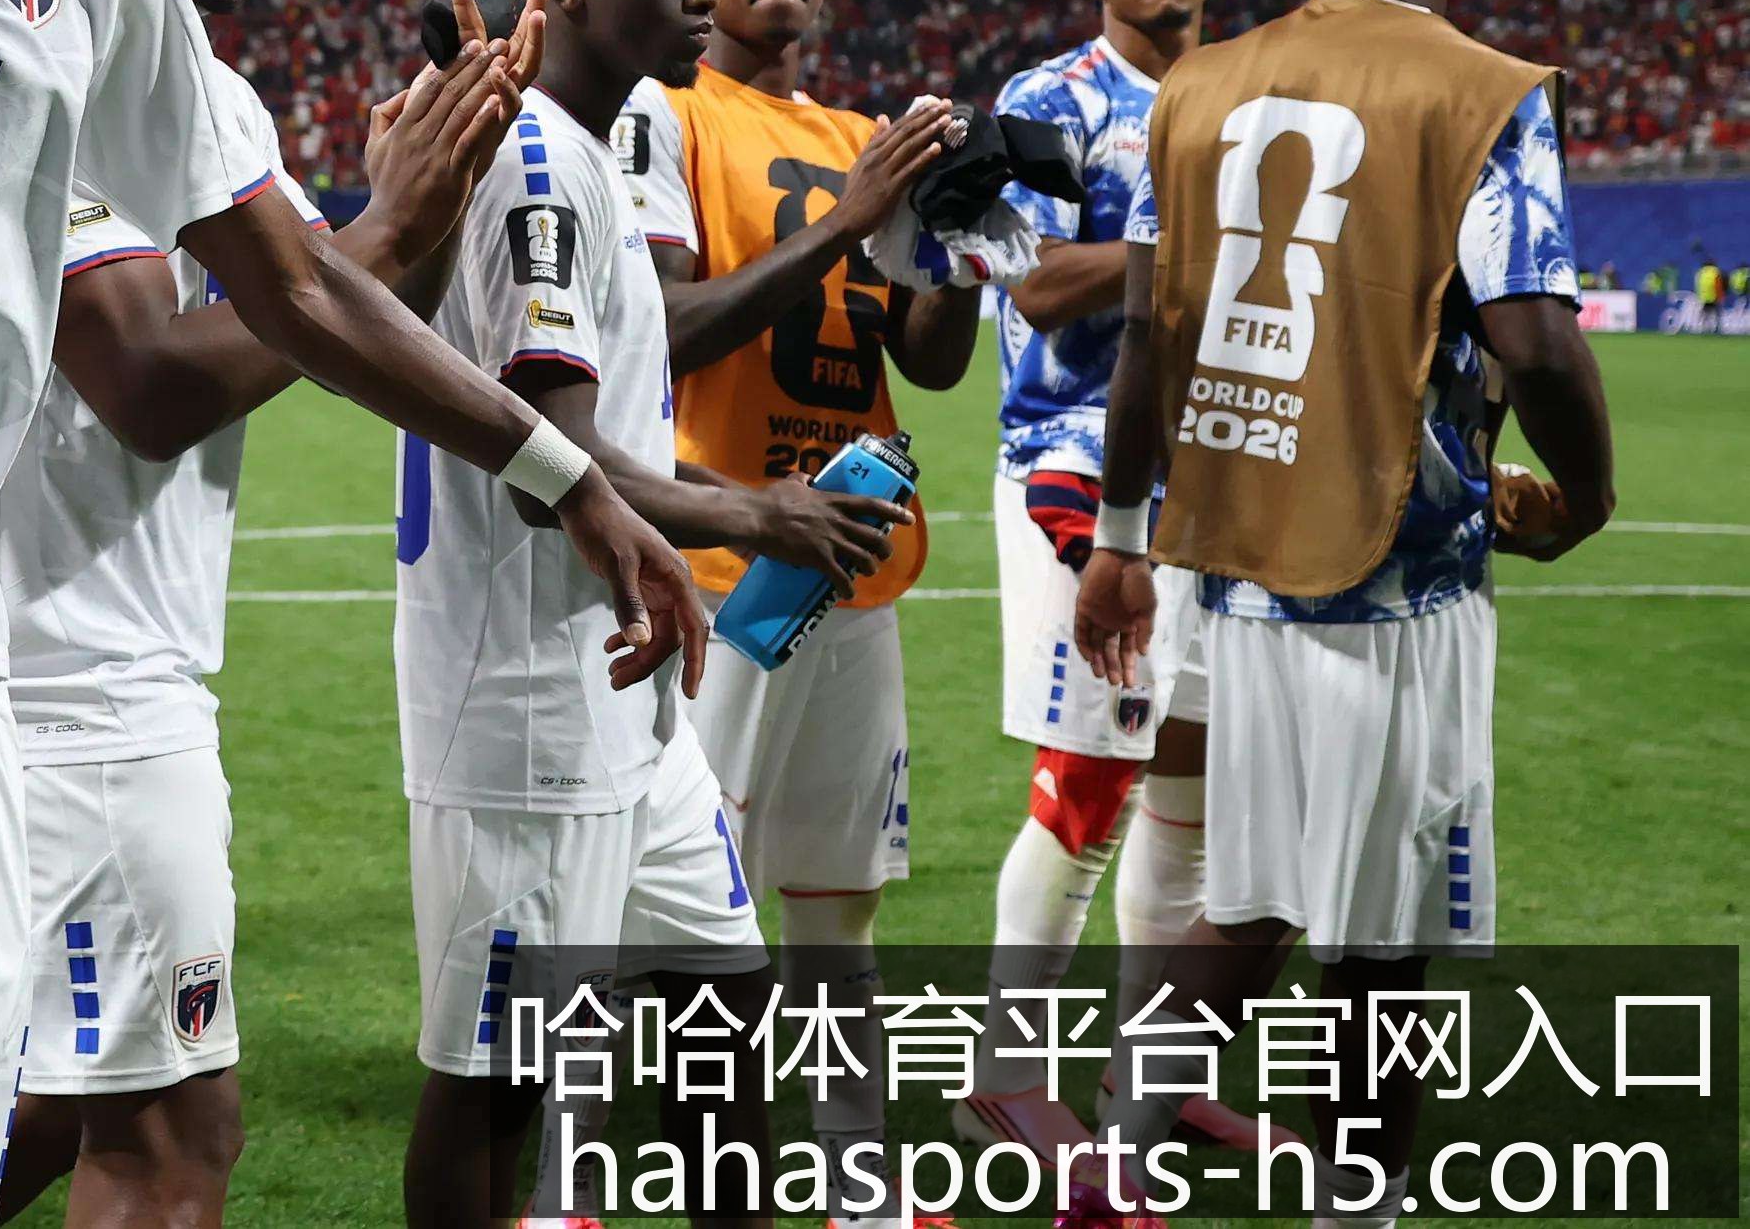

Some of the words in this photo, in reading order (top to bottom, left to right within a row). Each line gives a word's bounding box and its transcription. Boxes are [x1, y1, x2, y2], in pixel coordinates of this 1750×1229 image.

[540, 309, 572, 321] DEBUT
[1223, 316, 1292, 353] FIFA
[811, 355, 863, 391] FIFA
[1187, 376, 1272, 412] ORLD
[1273, 391, 1305, 421] CUP
[767, 415, 850, 445] WORLD
[850, 461, 872, 480] 21
[863, 436, 915, 476] POWERADE
[178, 960, 222, 982] FCF
